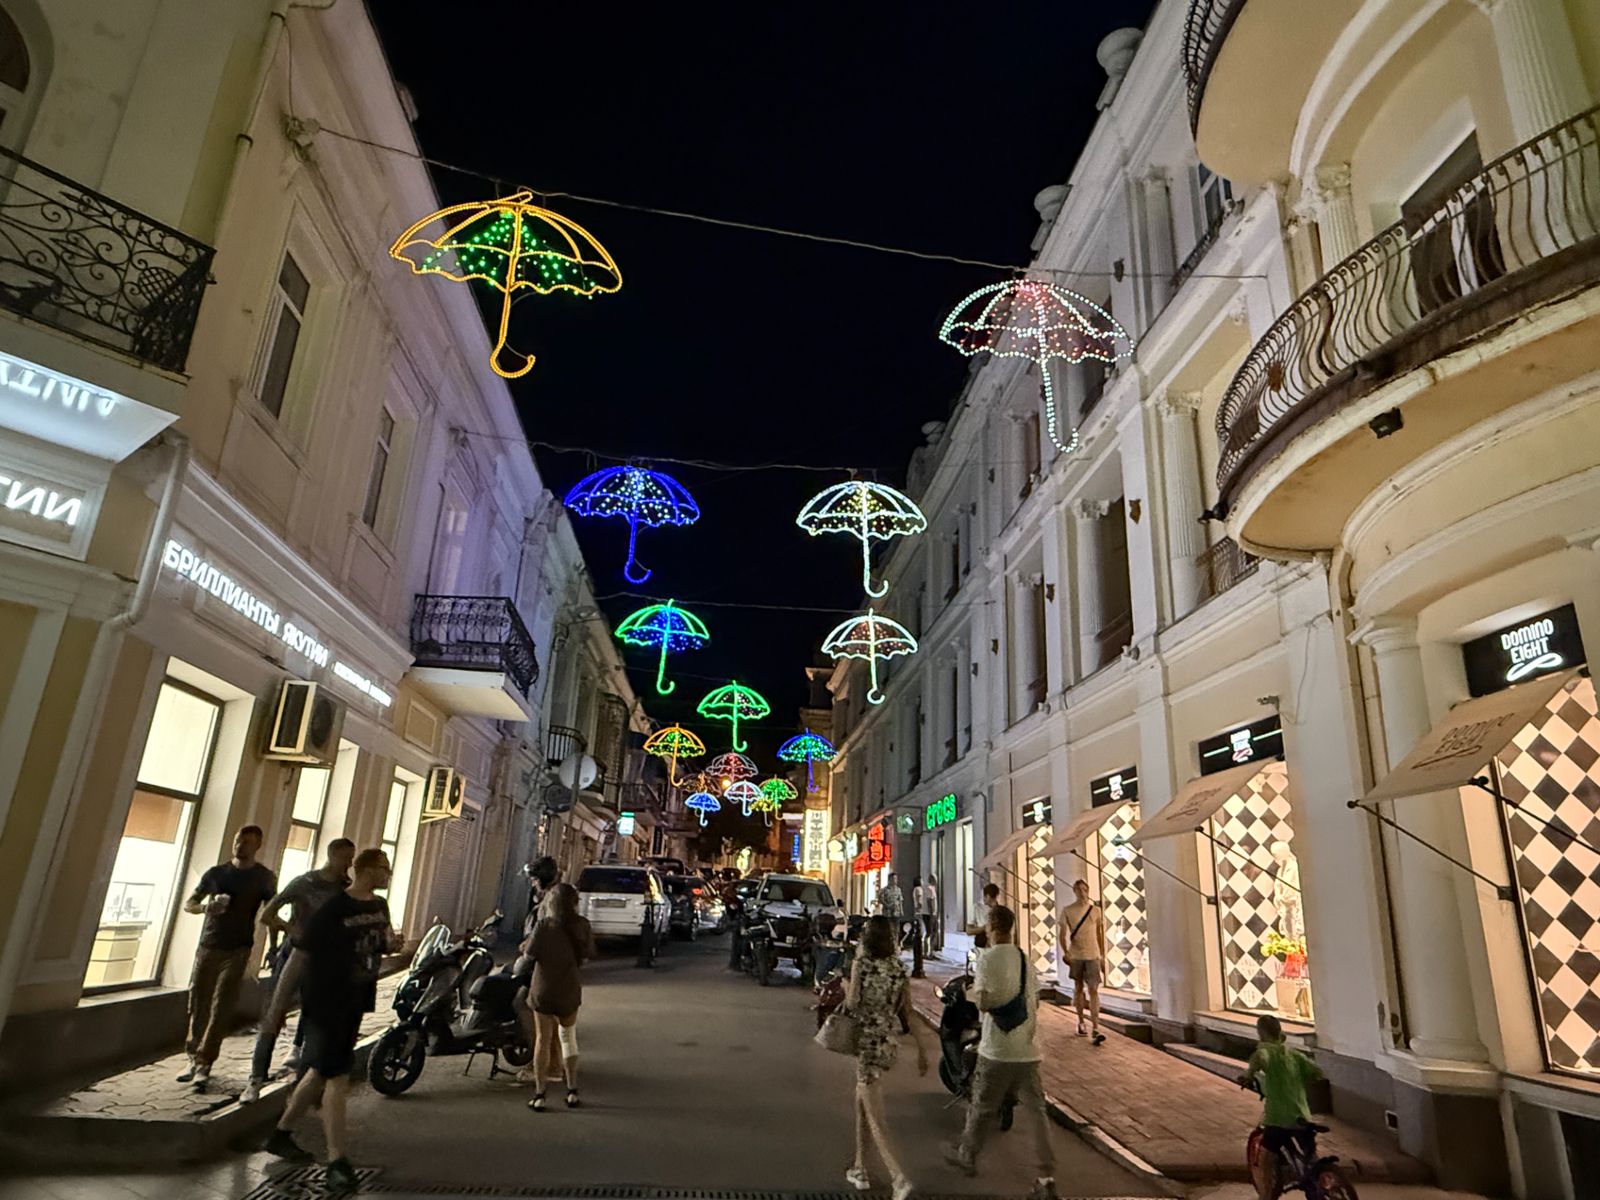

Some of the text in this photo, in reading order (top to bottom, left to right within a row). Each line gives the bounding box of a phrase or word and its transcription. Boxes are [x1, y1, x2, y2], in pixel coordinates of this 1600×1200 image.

[163, 539, 330, 668] БРИЛЛИАНТЫ ЯКУТИИ
[1501, 618, 1554, 650] DOMINO
[1510, 637, 1550, 664] EIGHT
[926, 793, 957, 830] crocs
